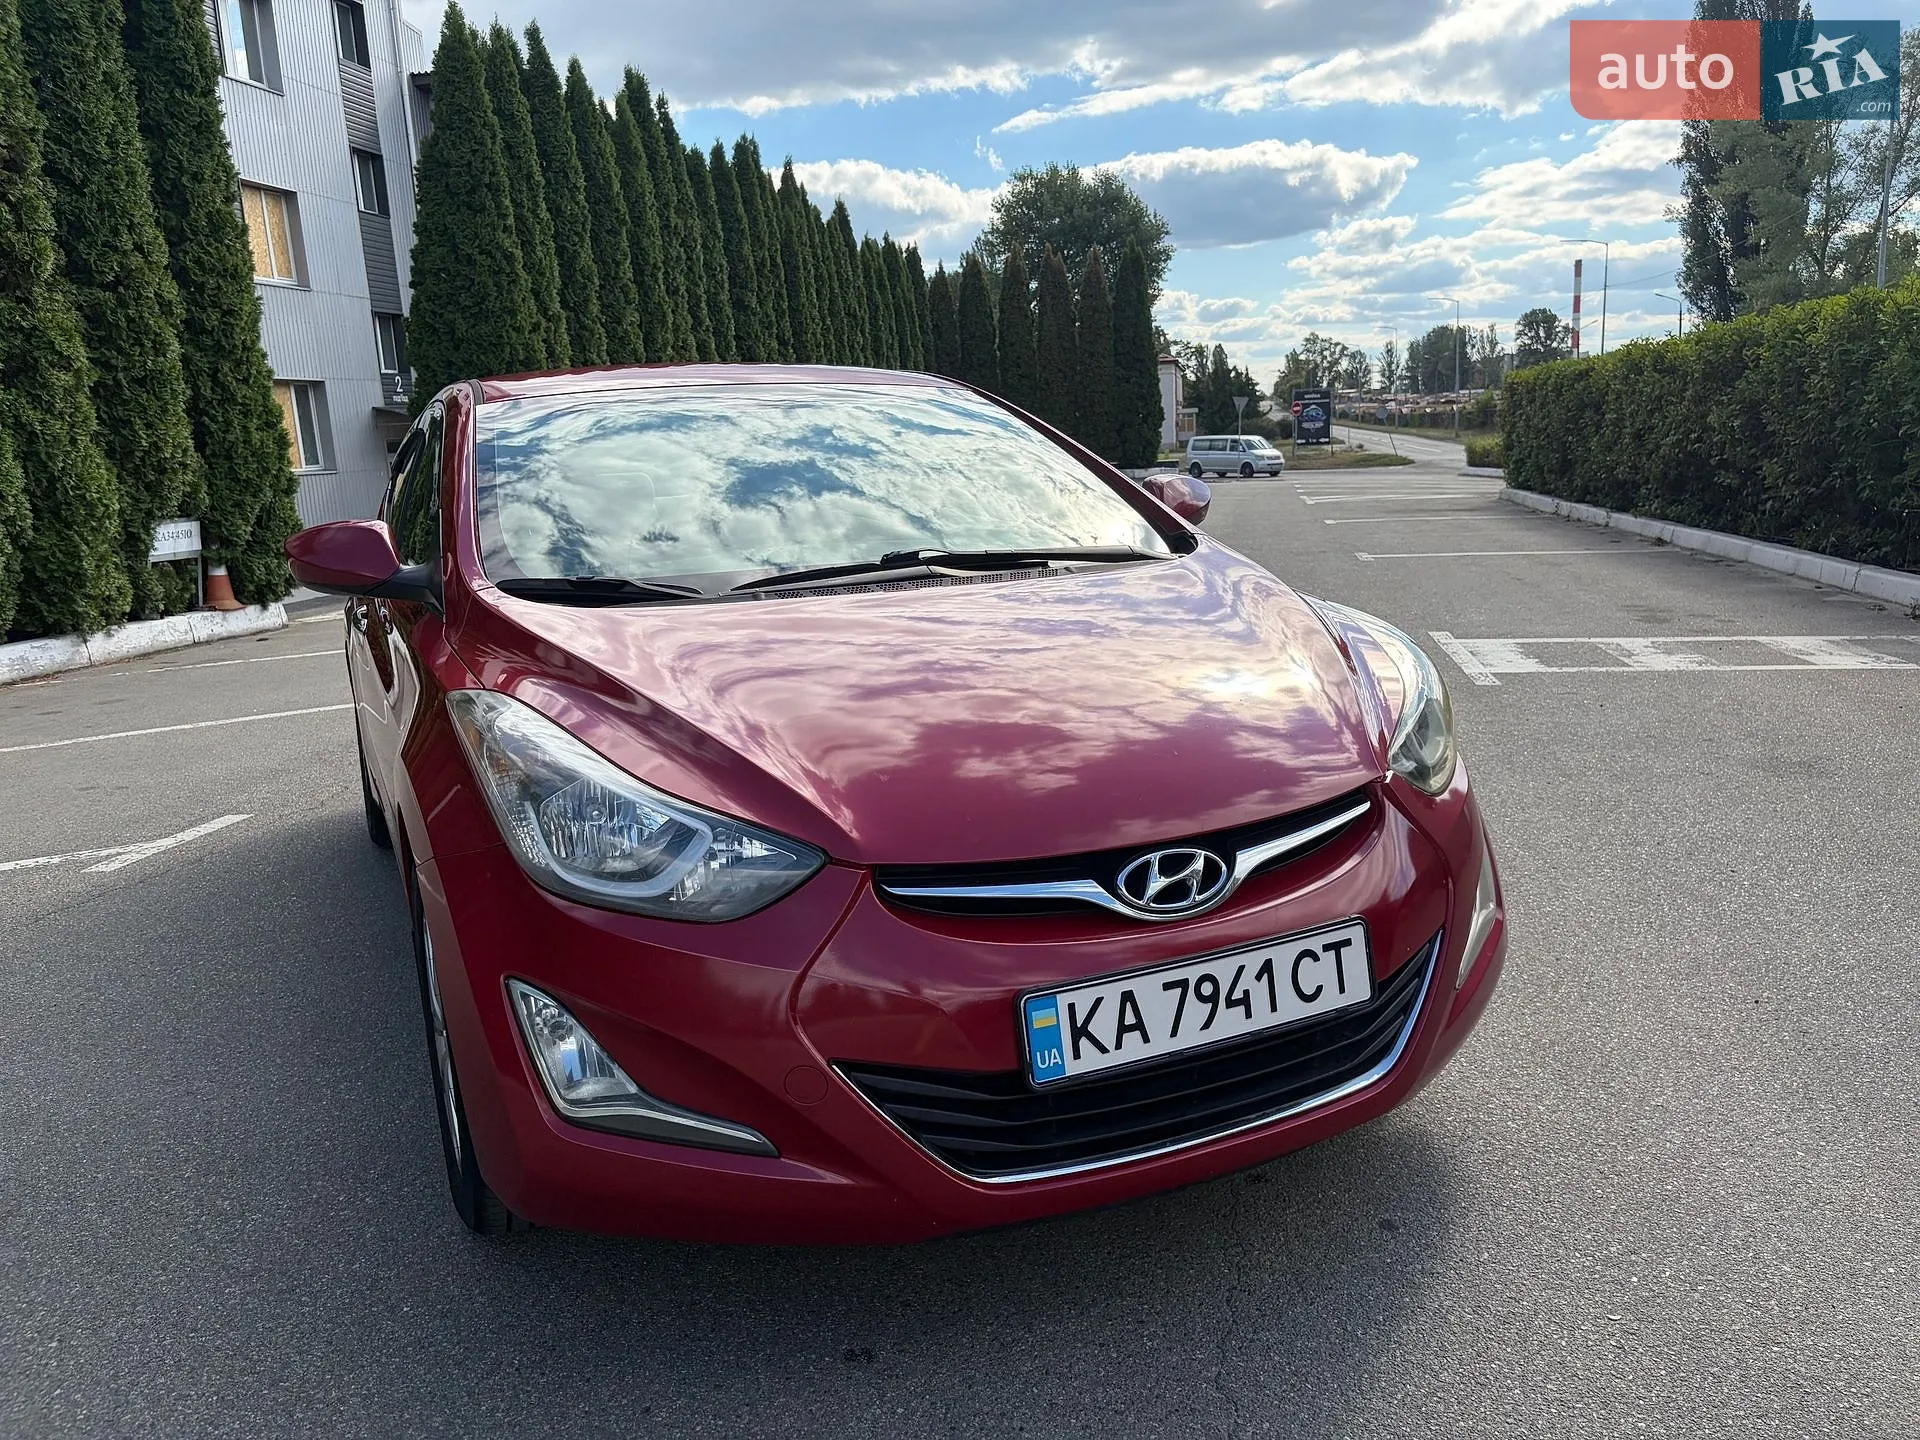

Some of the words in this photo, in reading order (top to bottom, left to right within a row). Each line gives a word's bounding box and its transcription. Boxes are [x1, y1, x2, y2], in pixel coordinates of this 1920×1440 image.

[395, 375, 404, 392] 2
[1067, 989, 1151, 1061] KA
[1161, 957, 1278, 1039] 7941
[1290, 937, 1353, 1004] CT
[1036, 1047, 1062, 1069] UA
